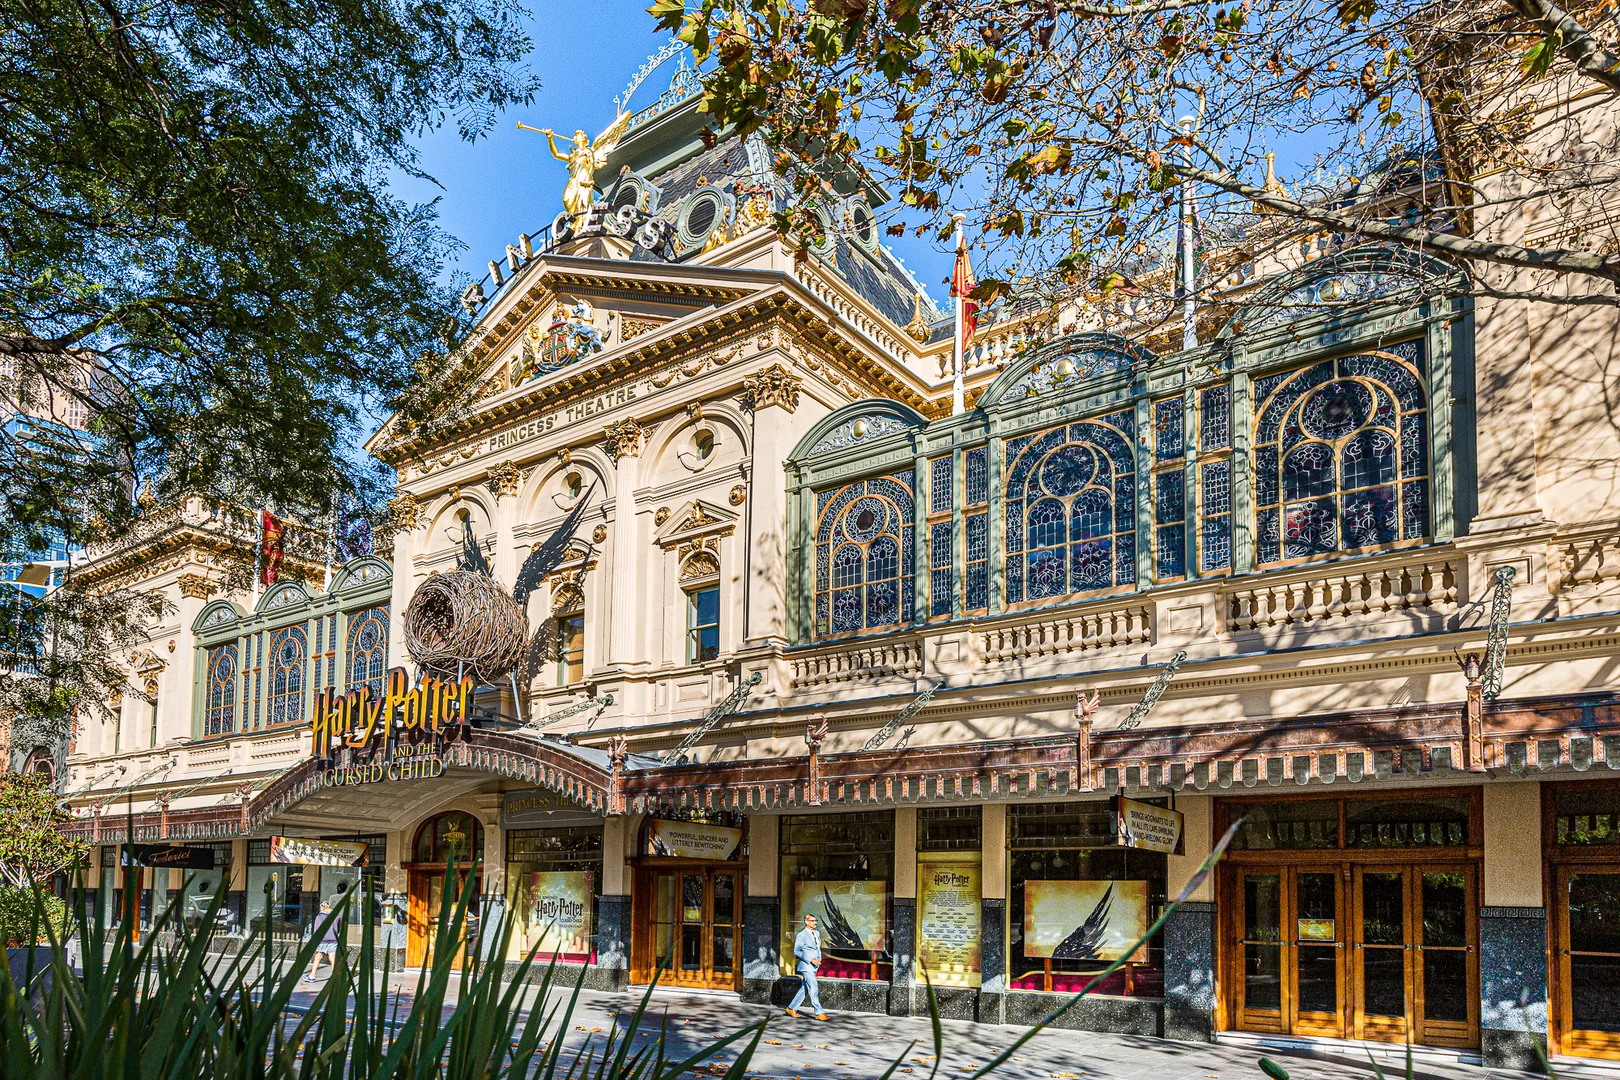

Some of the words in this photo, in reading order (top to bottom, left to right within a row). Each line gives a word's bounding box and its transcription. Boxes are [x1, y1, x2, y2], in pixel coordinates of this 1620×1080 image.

[489, 414, 558, 451] PRINCESS'
[566, 384, 637, 423] THEATRE
[308, 685, 385, 761] Harry
[383, 666, 476, 762] Potter
[392, 746, 414, 757] AND
[416, 743, 437, 755] THE
[324, 764, 386, 787] CURSED
[387, 758, 446, 781] CHILD
[506, 796, 550, 814] PRINCESS
[672, 839, 693, 847] UTTERLY
[148, 848, 191, 866] Federici
[535, 900, 559, 920] Harry
[559, 898, 584, 921] Potter
